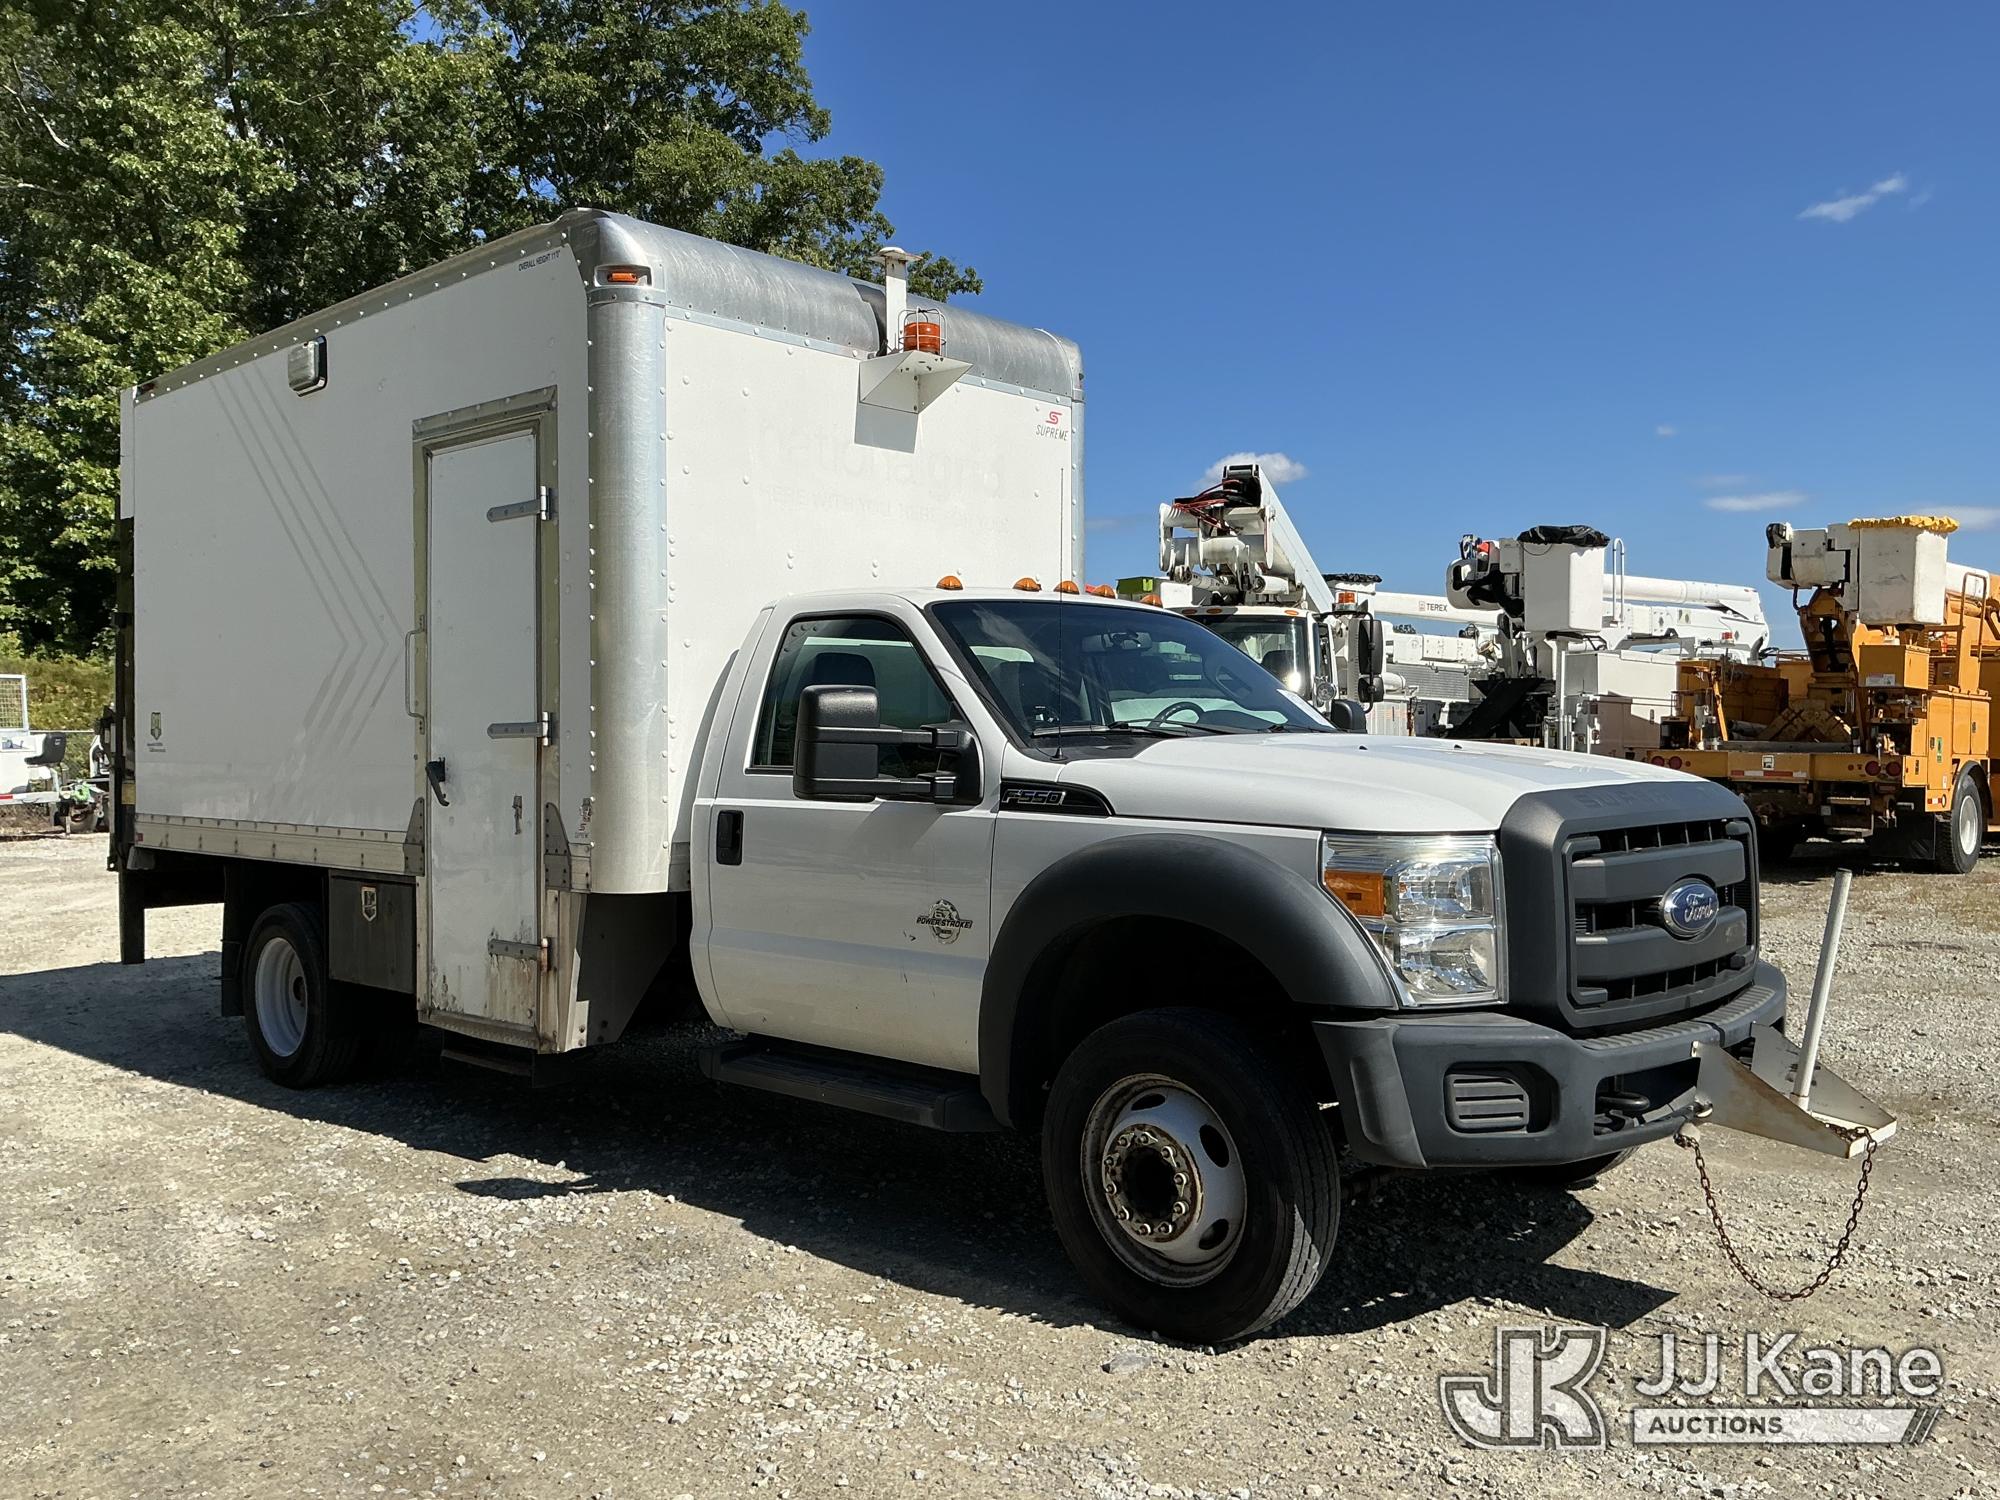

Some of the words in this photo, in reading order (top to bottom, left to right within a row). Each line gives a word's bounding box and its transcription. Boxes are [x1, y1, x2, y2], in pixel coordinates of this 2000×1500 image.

[1035, 424, 1069, 441] SUPREME
[1426, 603, 1448, 612] TEREX
[1684, 893, 1714, 923] Ford
